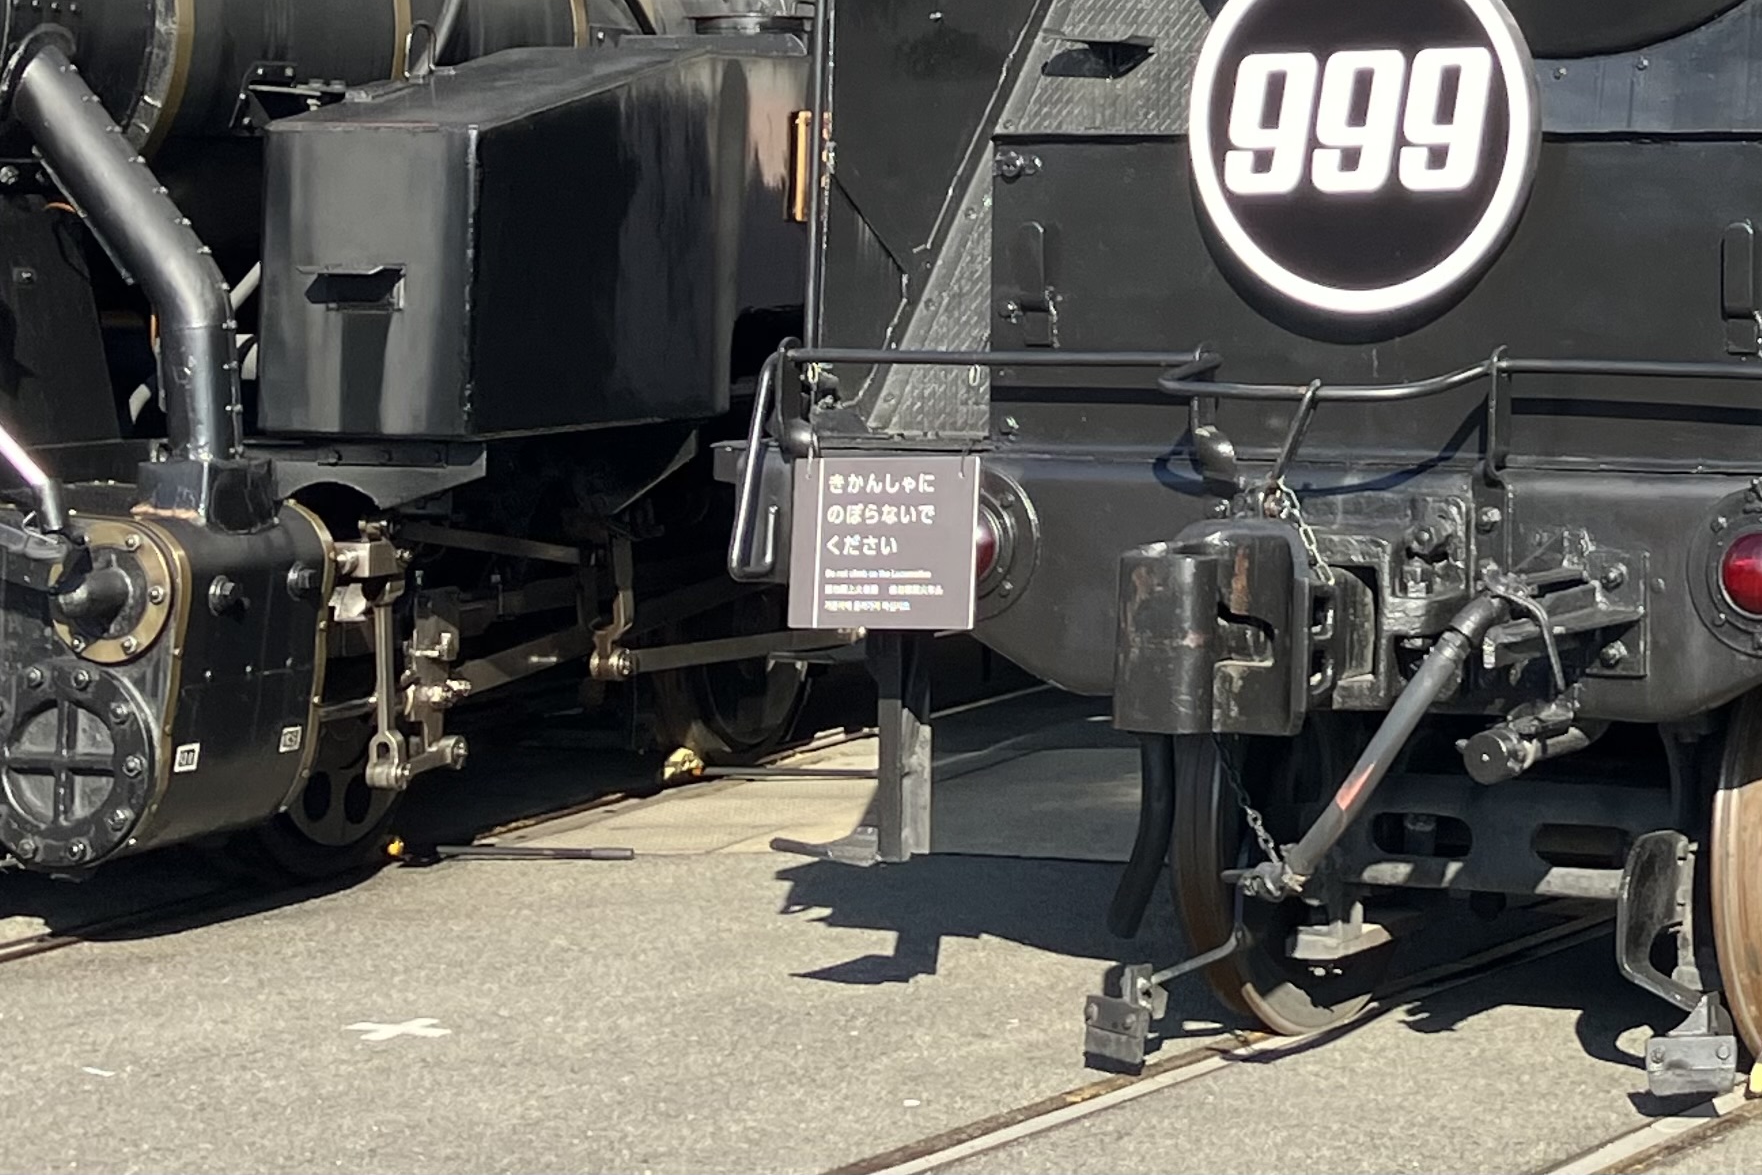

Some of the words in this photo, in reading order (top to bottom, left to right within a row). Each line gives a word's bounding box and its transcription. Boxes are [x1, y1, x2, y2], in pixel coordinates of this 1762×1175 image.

[1223, 46, 1492, 196] 999
[828, 473, 936, 494] きかんしゃに
[826, 503, 936, 525] のぼらないで
[826, 534, 898, 556] ください
